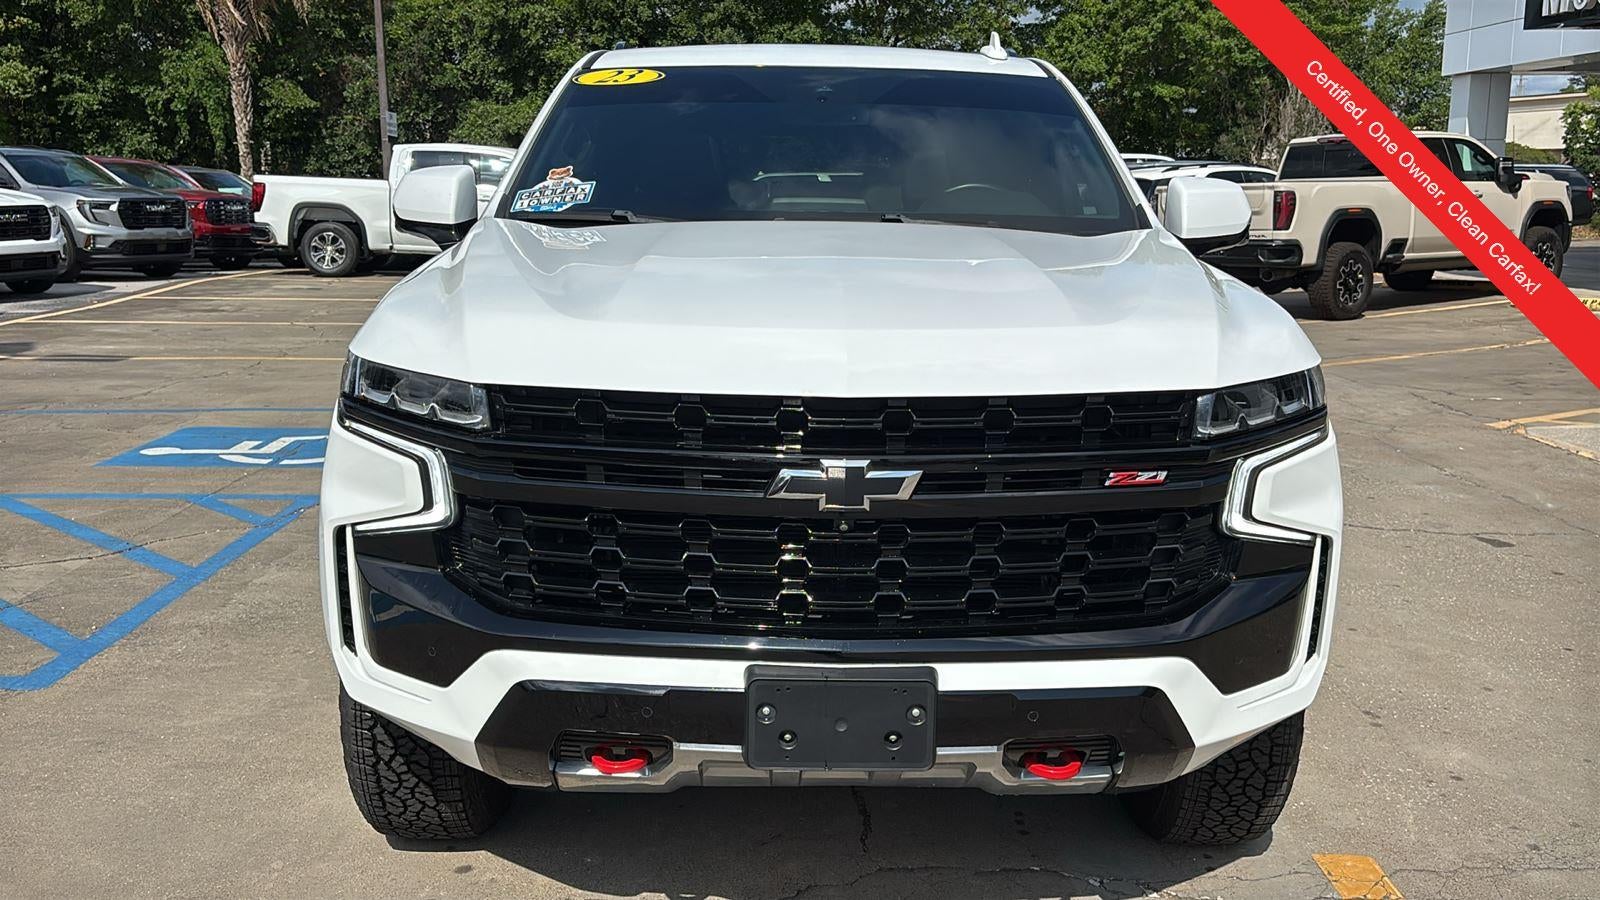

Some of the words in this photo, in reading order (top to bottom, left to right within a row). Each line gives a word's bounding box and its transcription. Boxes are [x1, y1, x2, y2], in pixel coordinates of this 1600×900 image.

[593, 69, 643, 84] 23
[521, 186, 589, 200] CARFAX
[529, 194, 586, 206] OWNER
